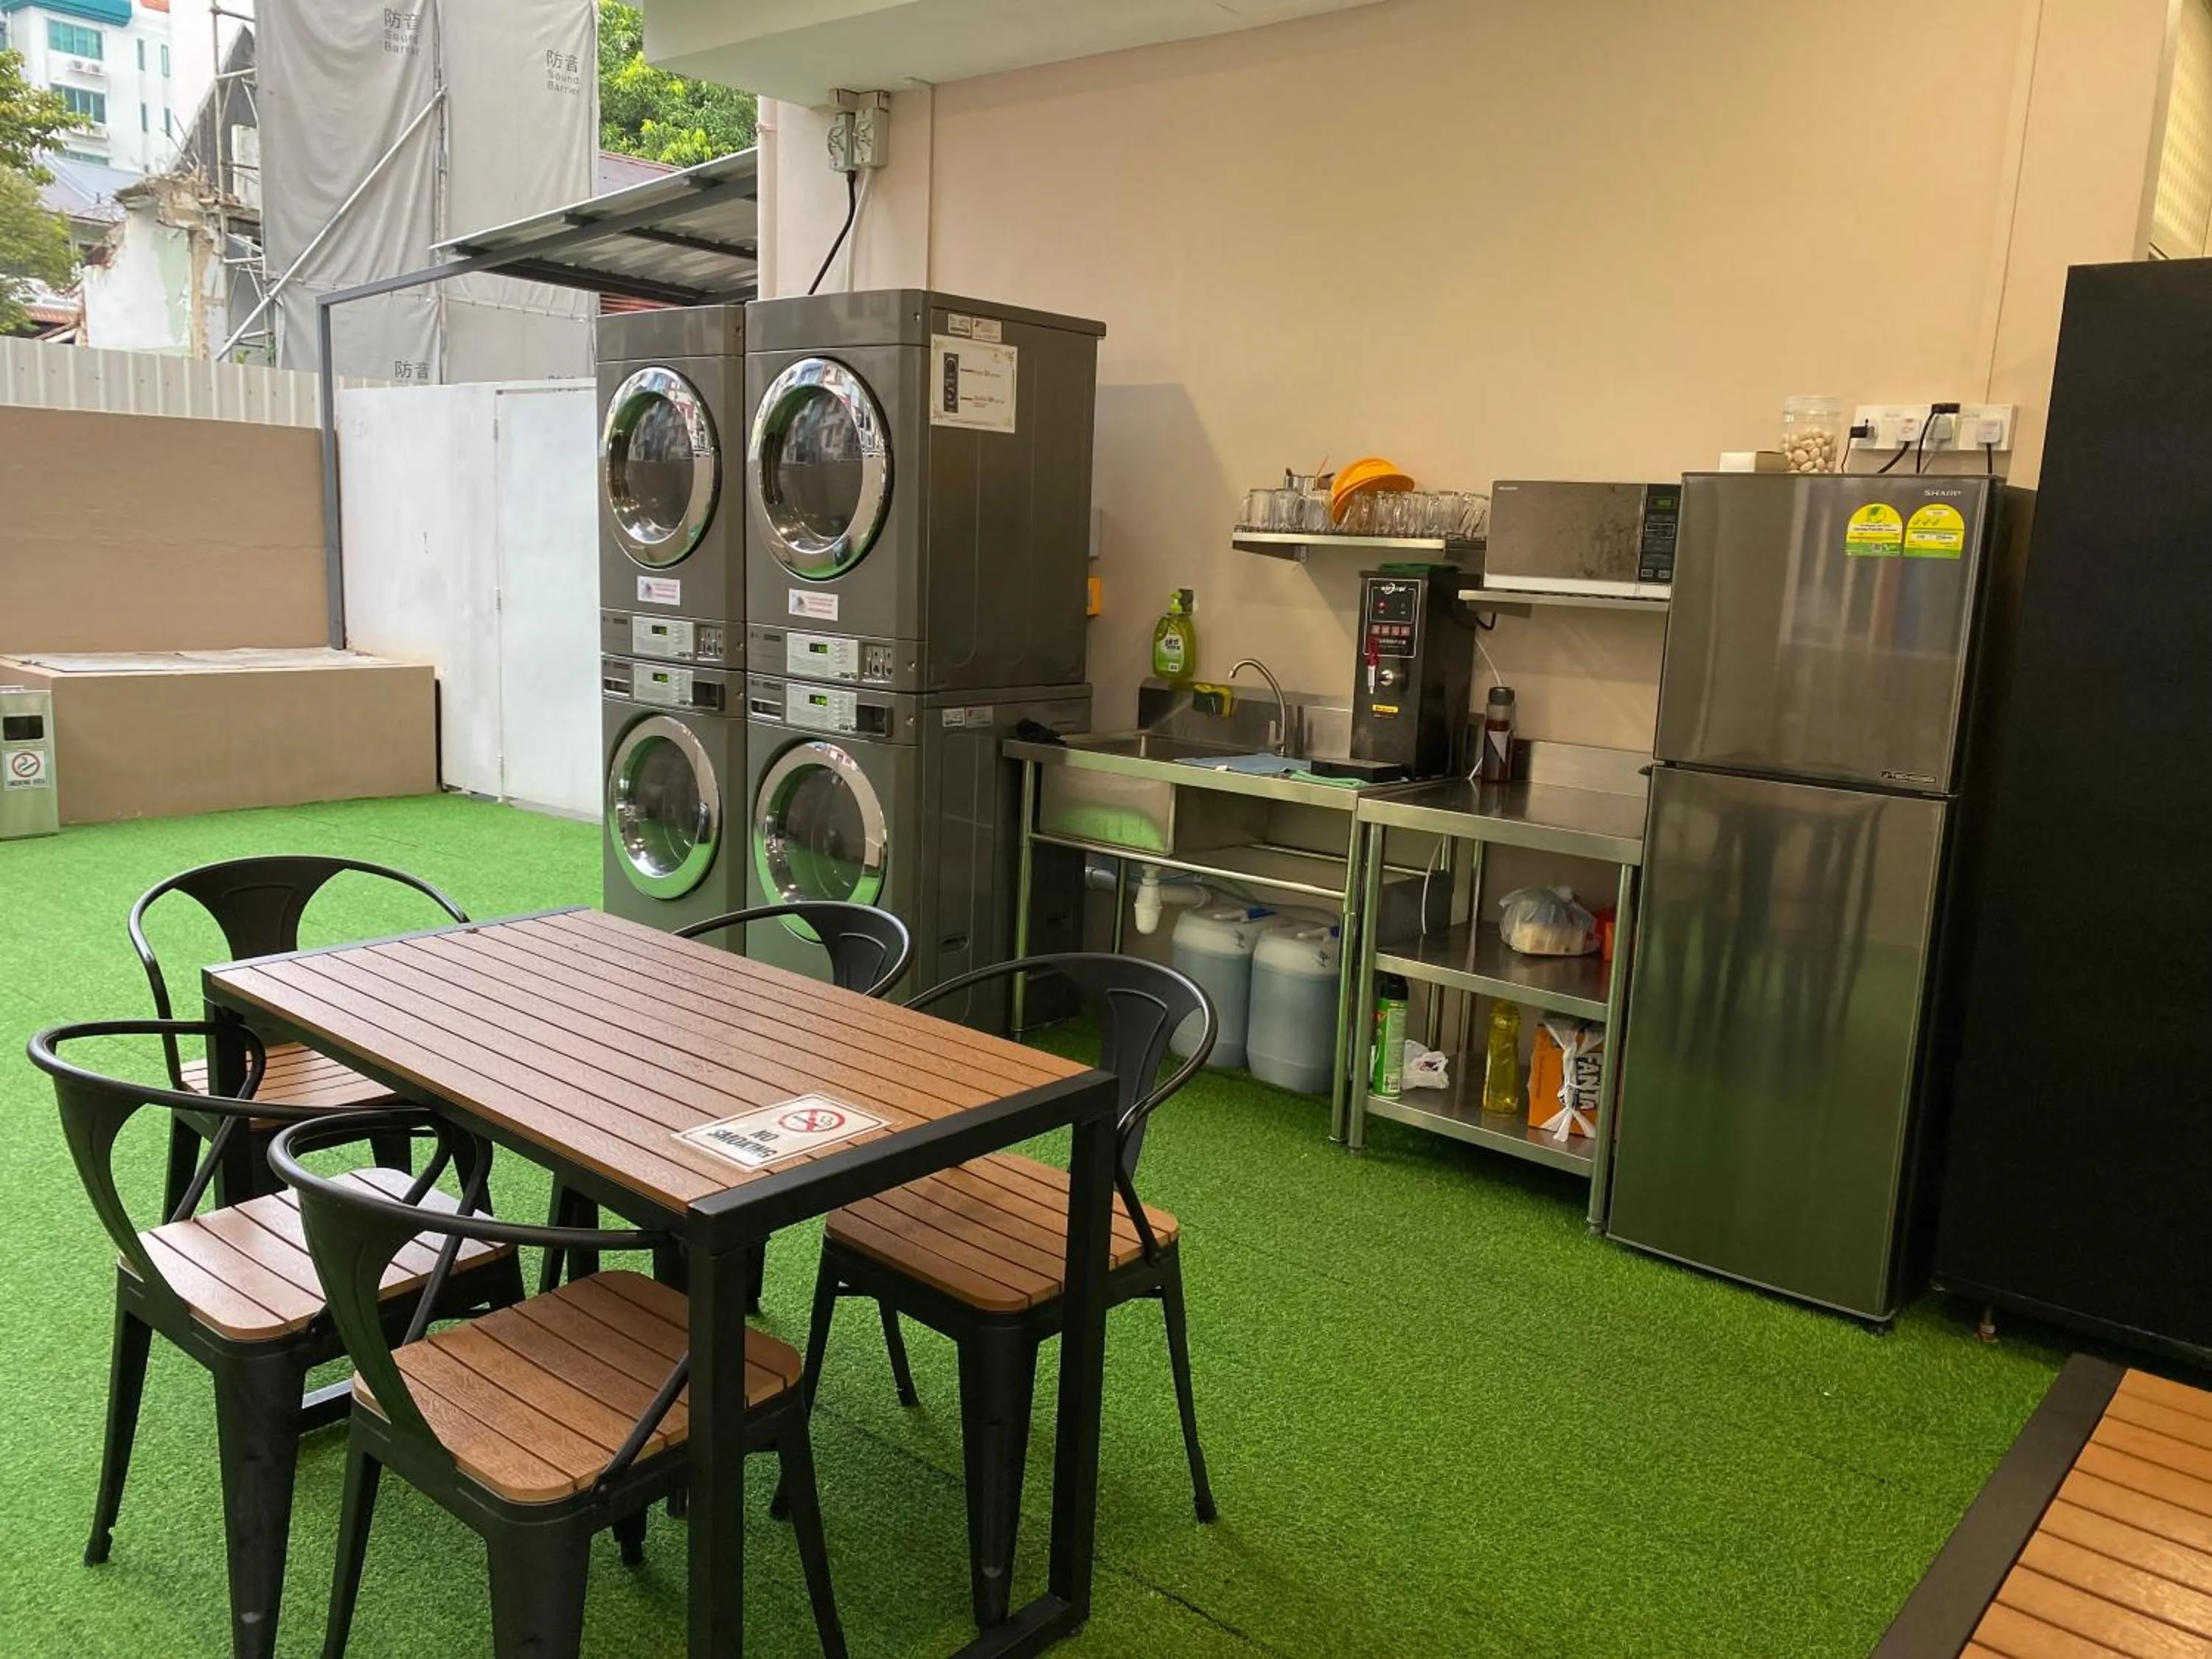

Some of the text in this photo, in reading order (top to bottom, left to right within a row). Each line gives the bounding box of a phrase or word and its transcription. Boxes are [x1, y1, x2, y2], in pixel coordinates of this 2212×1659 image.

[384, 8, 421, 30] 防音
[546, 49, 578, 73] 防音
[547, 69, 579, 84] Sound
[394, 361, 429, 379] 防音
[1576, 1051, 1603, 1110] FANTA
[706, 1129, 778, 1158] SMOKING
[748, 1130, 779, 1142] NO
